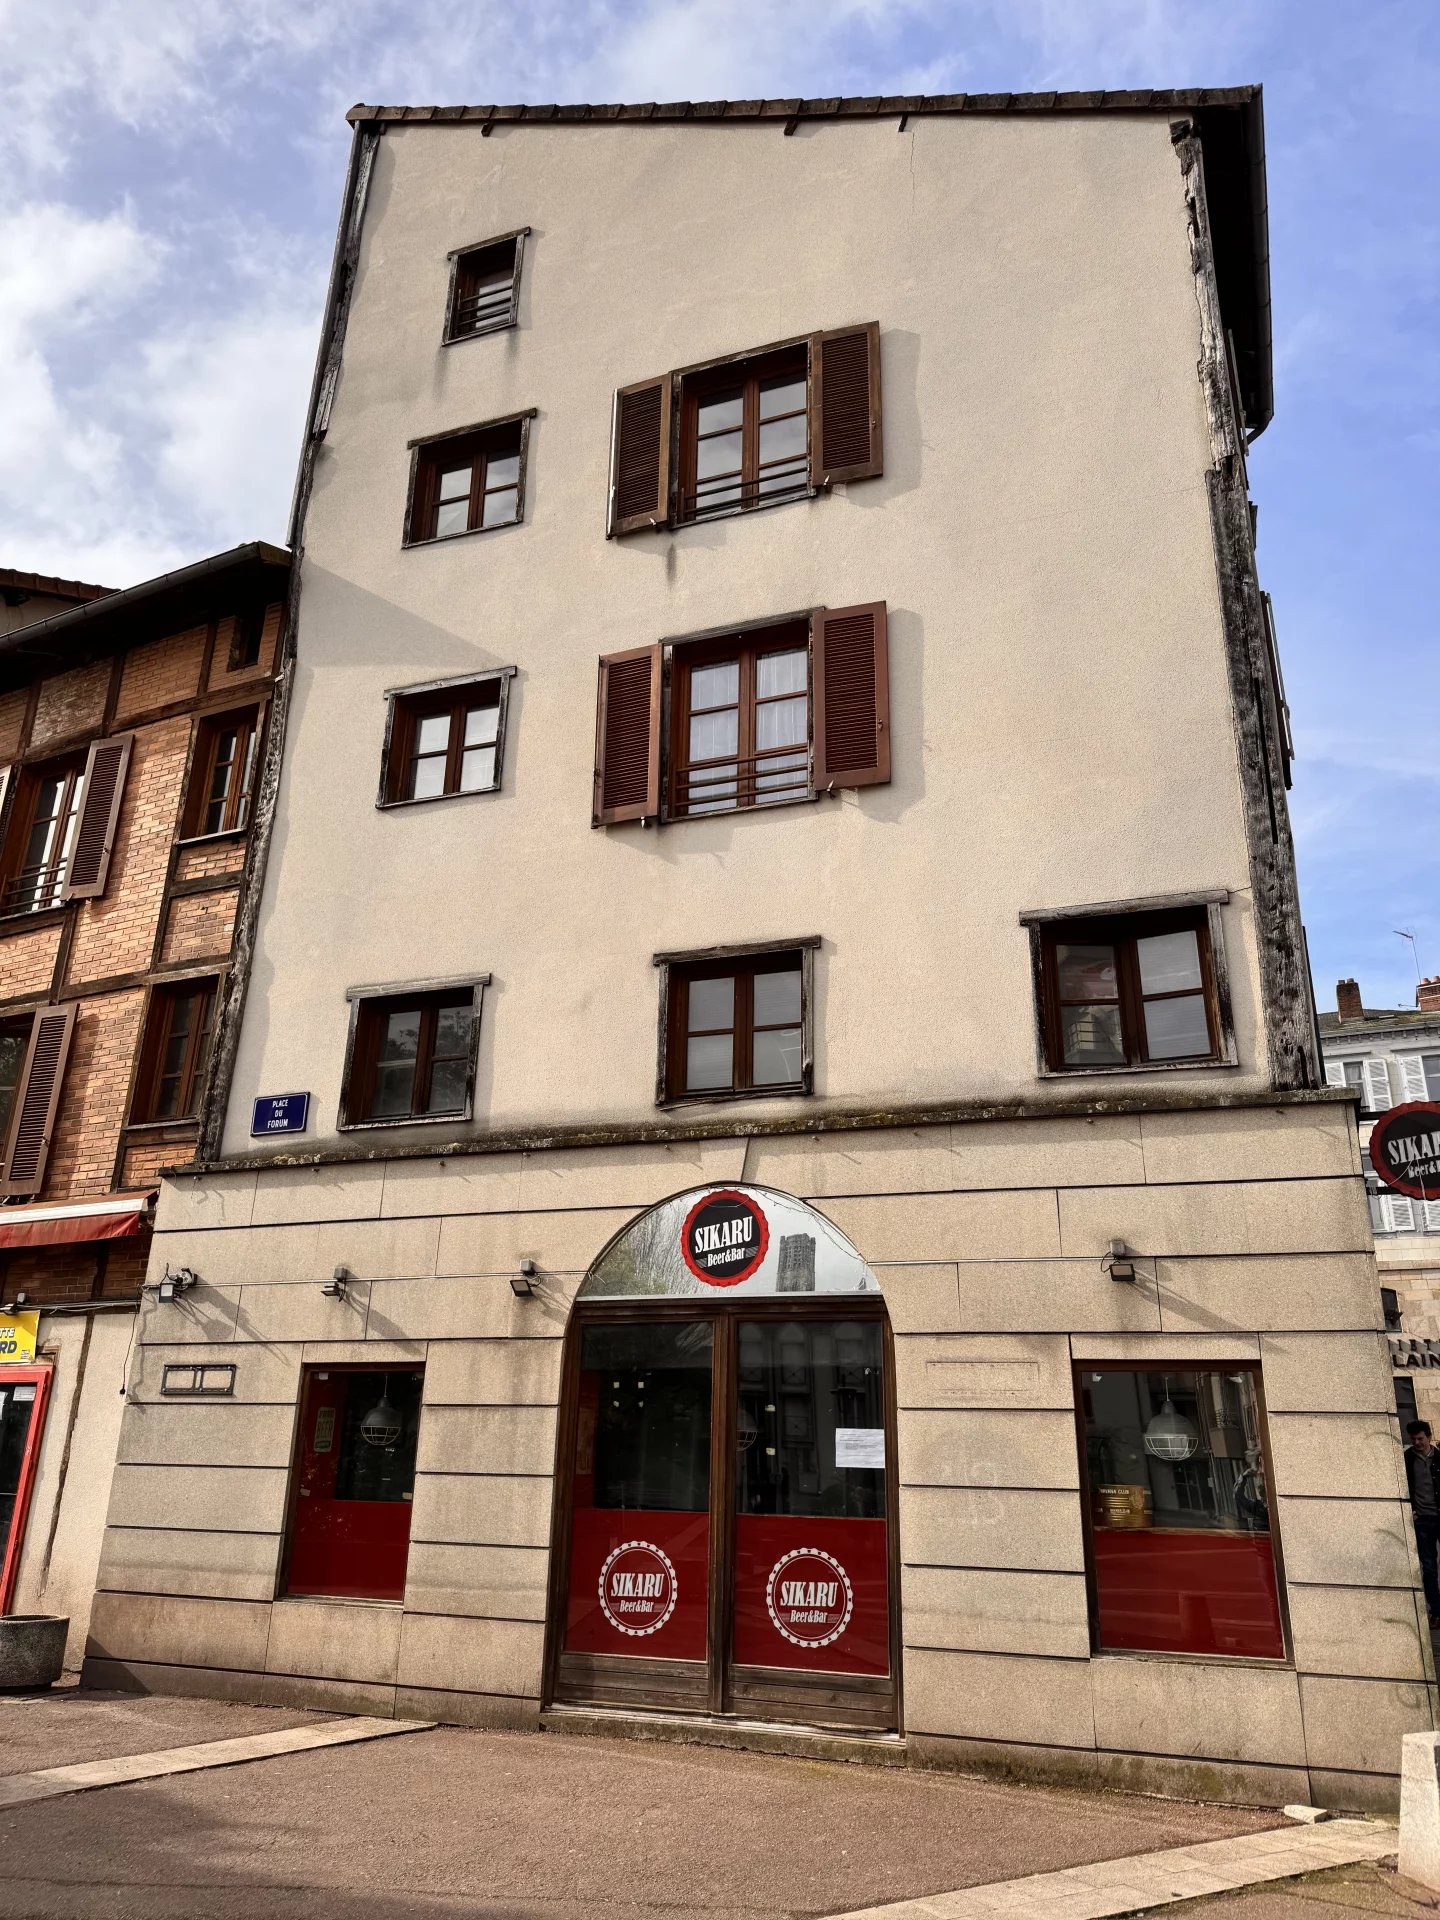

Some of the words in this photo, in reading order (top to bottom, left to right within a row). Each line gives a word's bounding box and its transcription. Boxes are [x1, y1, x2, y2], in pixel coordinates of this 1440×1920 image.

[272, 1099, 289, 1108] PLACE
[274, 1109, 284, 1118] DU
[267, 1118, 289, 1129] FORUM
[694, 1215, 753, 1254] SIKARU
[707, 1247, 746, 1268] Beer&Bar
[610, 1572, 665, 1598] SIKARU
[780, 1581, 839, 1608] SIKARU
[619, 1599, 655, 1613] Beer&Bar
[790, 1609, 828, 1624] Beer&Bar
